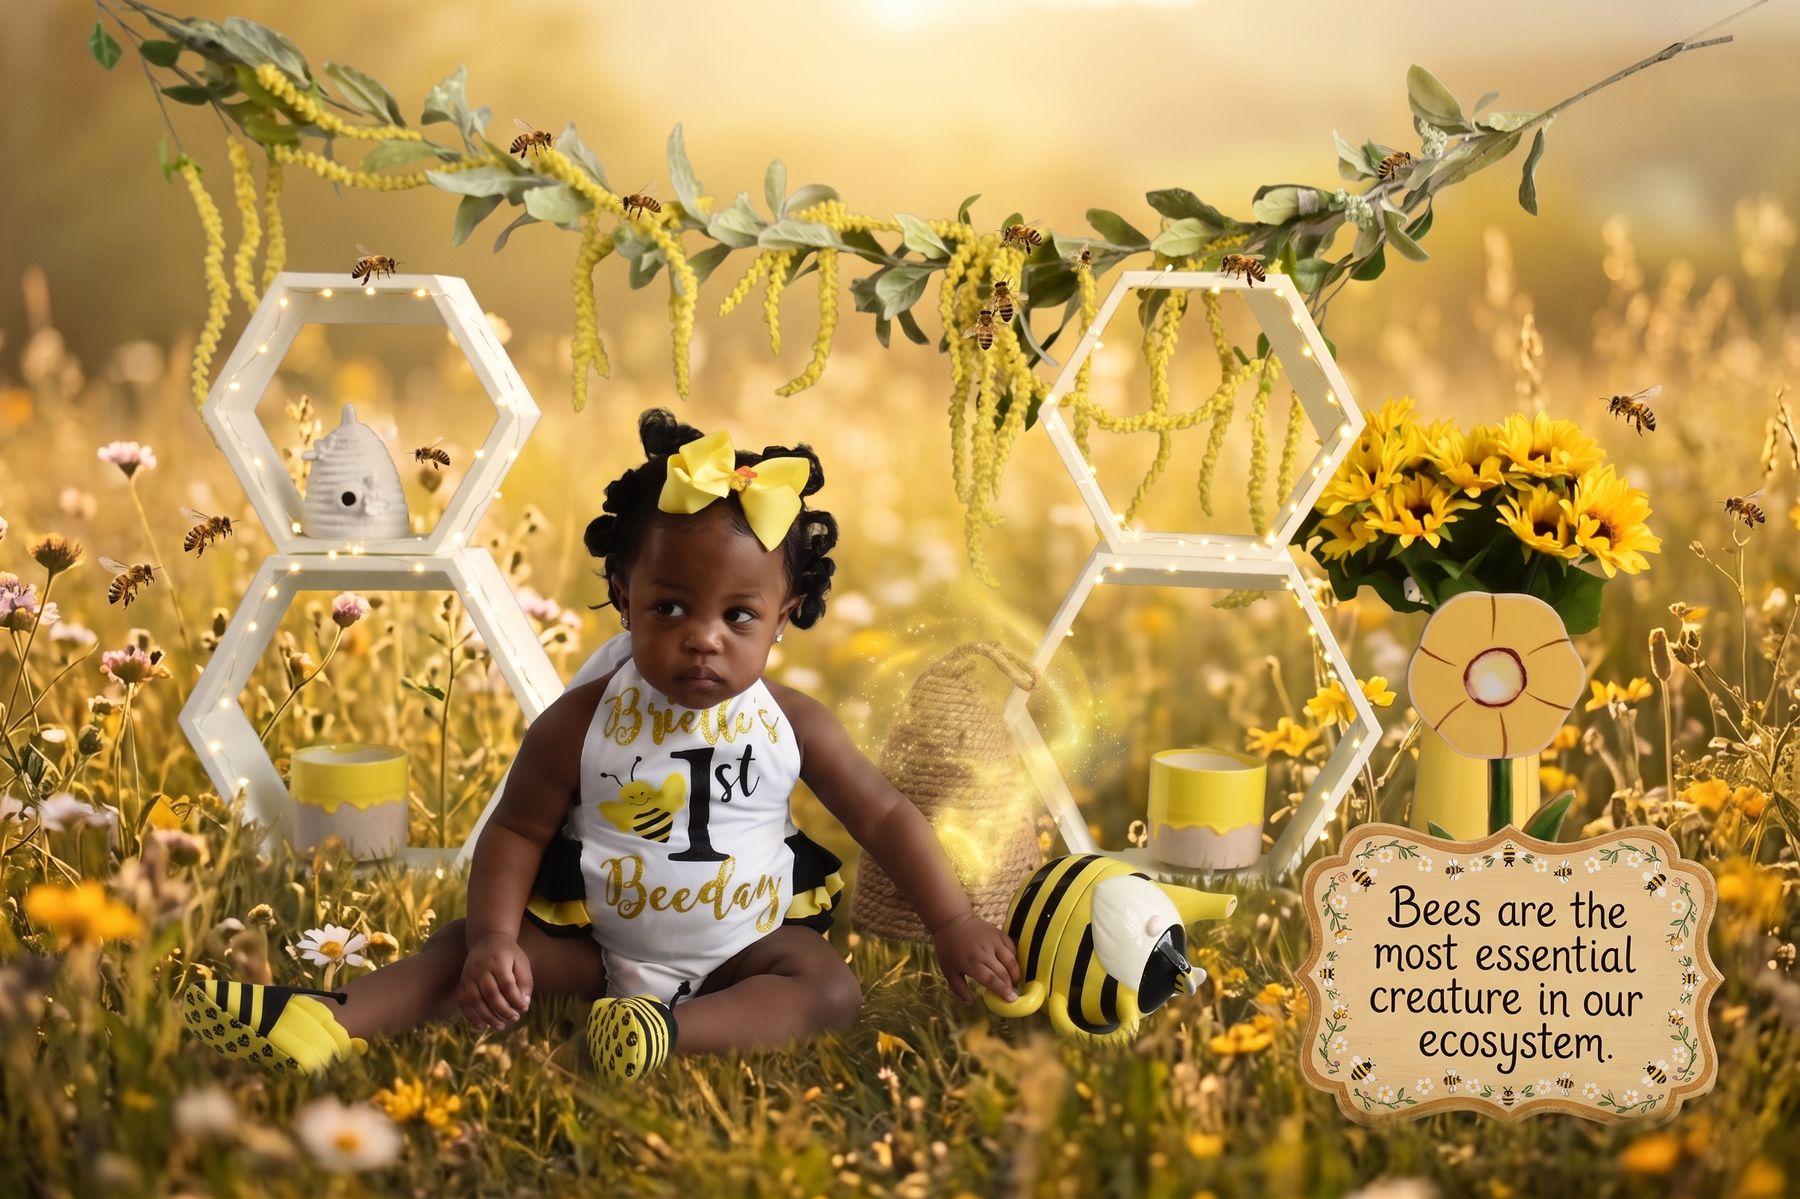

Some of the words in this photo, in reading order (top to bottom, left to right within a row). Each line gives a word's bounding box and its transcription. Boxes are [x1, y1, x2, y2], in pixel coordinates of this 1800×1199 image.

[603, 686, 779, 746] Brielle's
[668, 744, 760, 862] 1st
[600, 855, 782, 934] Beeday
[1387, 884, 1481, 929] Bees
[1498, 901, 1557, 928] are
[1569, 890, 1628, 930] the
[1373, 933, 1458, 972] most
[1475, 934, 1637, 974] essential
[1369, 977, 1522, 1015] creature
[1537, 982, 1571, 1018] in
[1583, 990, 1644, 1018] our
[1419, 1022, 1613, 1075] ecosystem.
